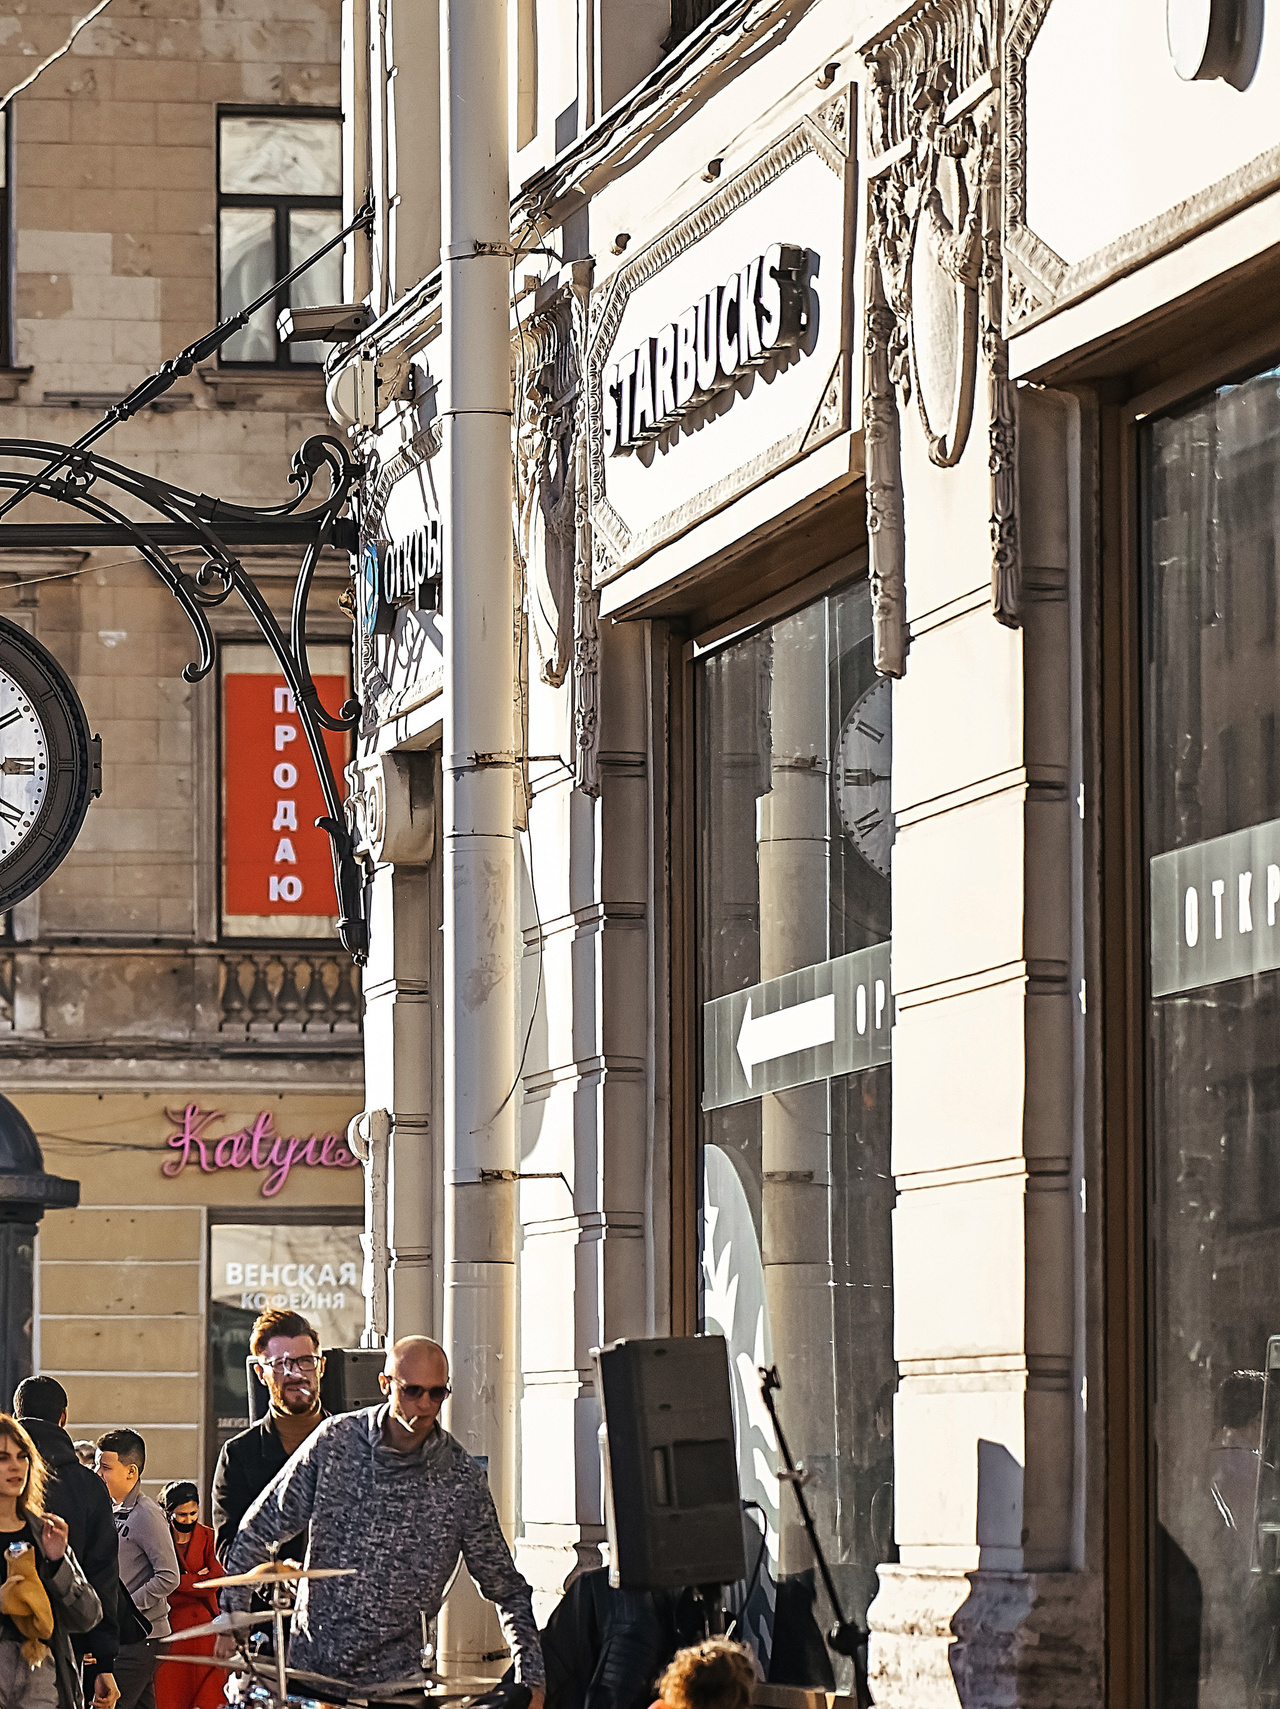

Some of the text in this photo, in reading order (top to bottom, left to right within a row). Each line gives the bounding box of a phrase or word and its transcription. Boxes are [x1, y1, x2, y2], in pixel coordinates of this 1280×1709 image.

[602, 242, 784, 456] STARBUCKS
[268, 687, 303, 903] ПРОДАЮ
[1185, 864, 1280, 948] ОТКР
[226, 1262, 357, 1287] ВЕНСКАЯ
[241, 1291, 346, 1310] КОФЕЙНЯ
